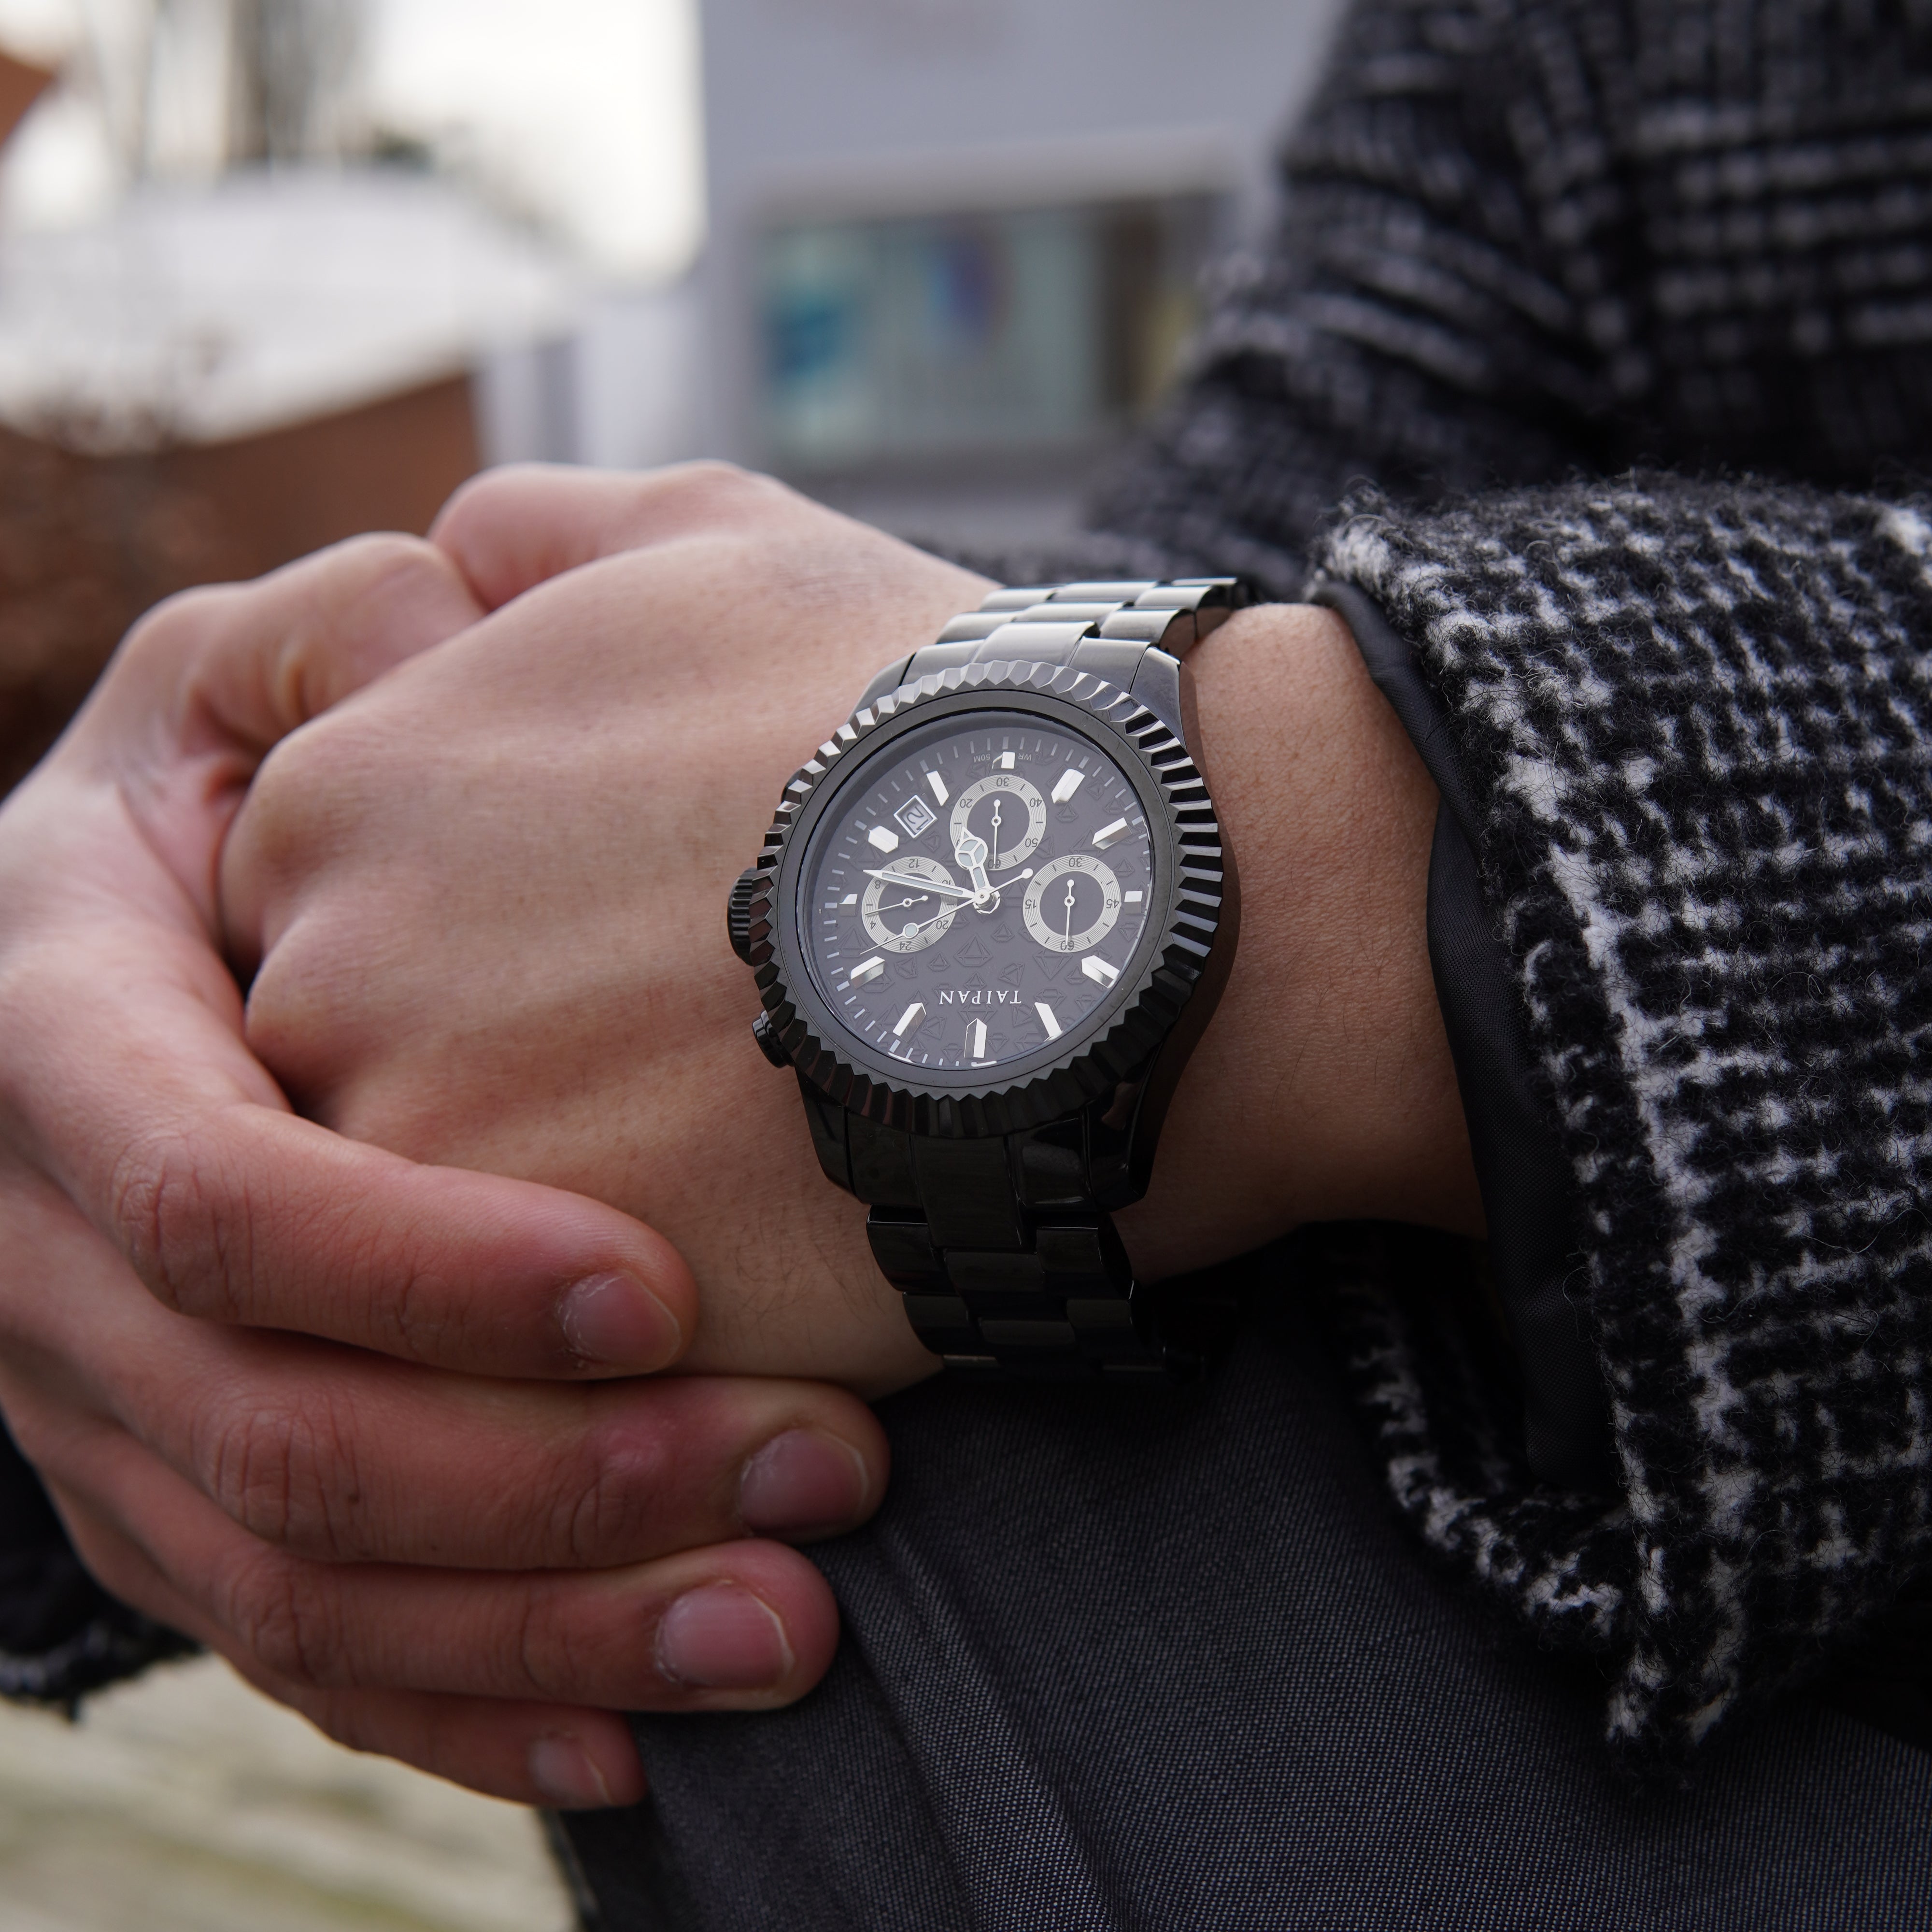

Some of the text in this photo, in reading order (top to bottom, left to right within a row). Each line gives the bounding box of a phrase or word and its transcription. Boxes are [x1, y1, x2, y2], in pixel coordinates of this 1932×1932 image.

[973, 753, 1032, 763] WR 50M
[995, 777, 1009, 787] 30
[959, 798, 973, 808] 20
[1029, 797, 1042, 808] 40
[906, 806, 928, 830] 12
[1024, 838, 1038, 848] 50
[908, 858, 920, 868] 12
[988, 859, 1001, 869] 60
[1068, 857, 1082, 867] 30
[874, 880, 881, 889] 8
[1024, 898, 1037, 909] 15
[1106, 898, 1120, 909] 45
[869, 921, 876, 930] 4
[936, 920, 949, 930] 20
[899, 941, 912, 951] 24
[1060, 940, 1074, 951] 60
[938, 990, 1022, 1005] TAIPAN
